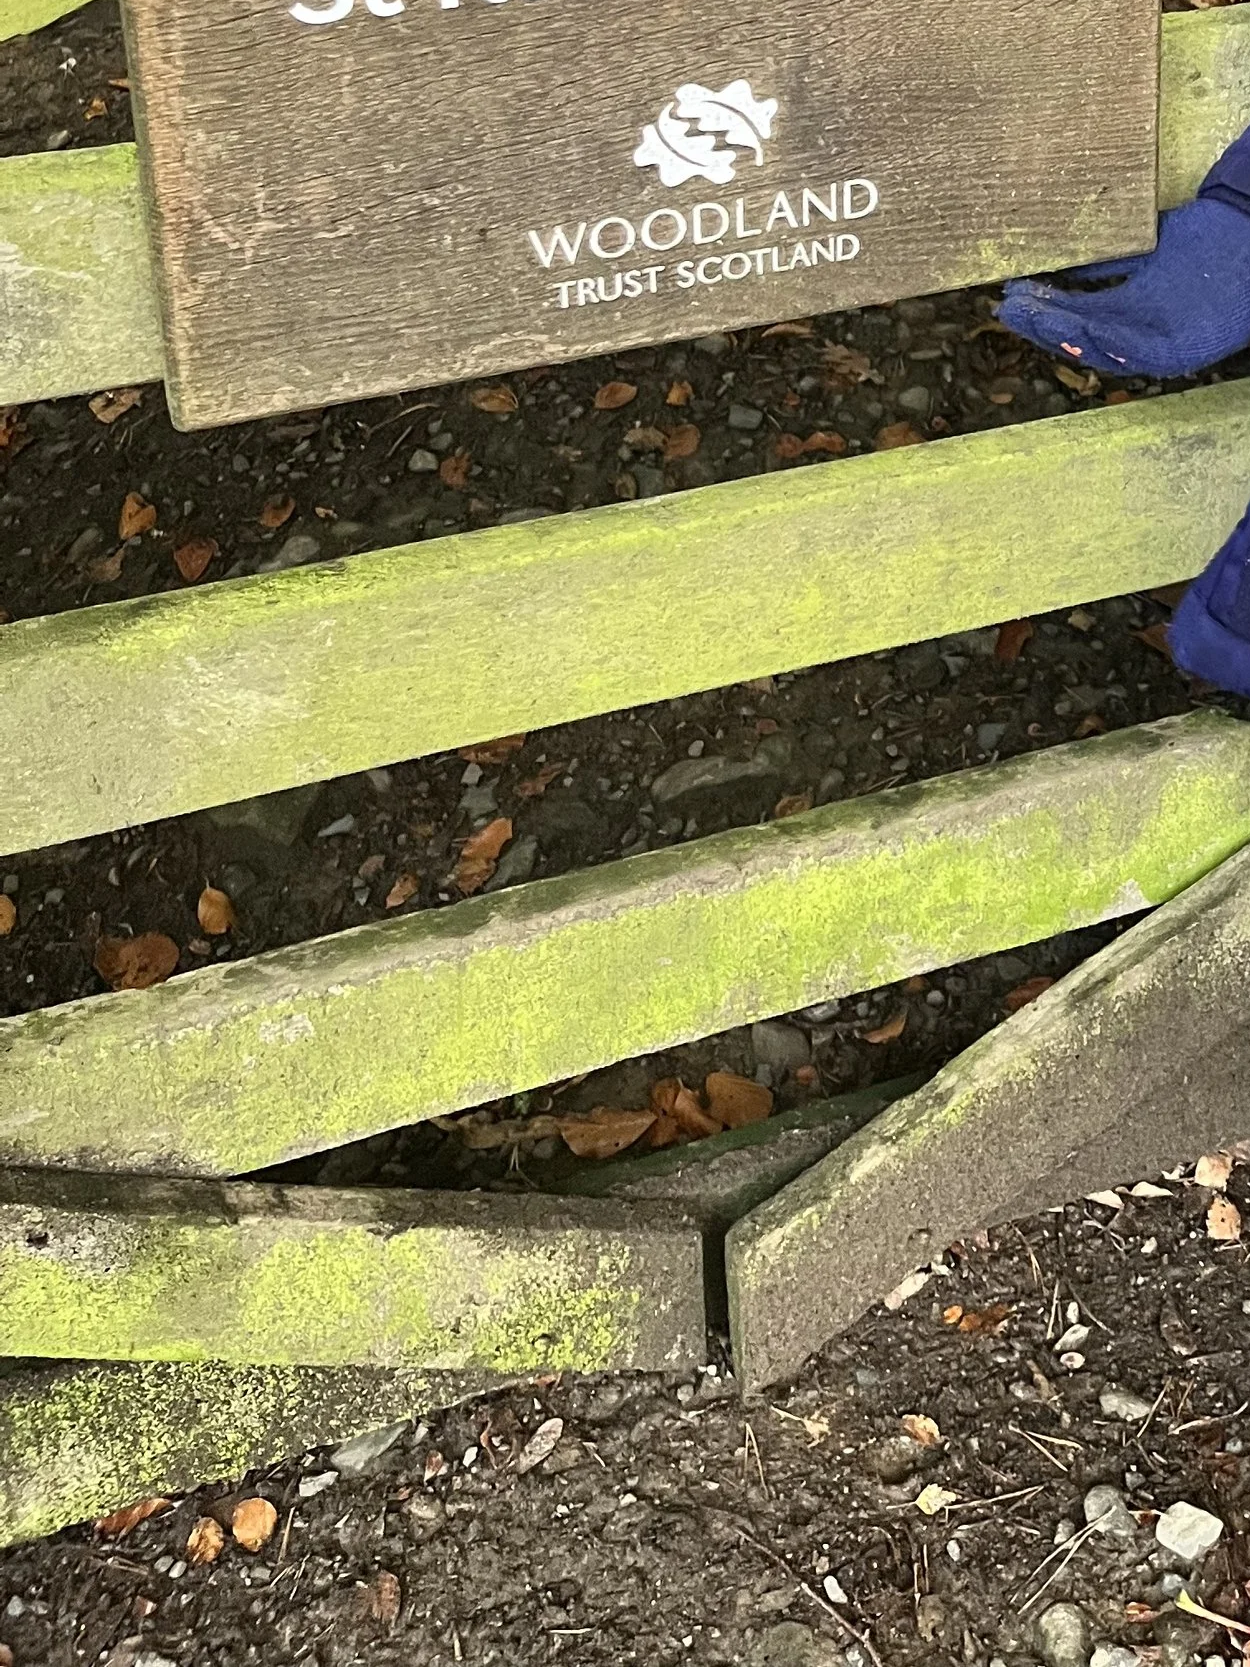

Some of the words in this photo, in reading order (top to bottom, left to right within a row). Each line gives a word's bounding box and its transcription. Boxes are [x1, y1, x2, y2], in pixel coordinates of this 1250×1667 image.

[527, 177, 880, 269] WOODLAND
[553, 265, 666, 310] TRUST
[675, 233, 861, 291] SCOTLAND
